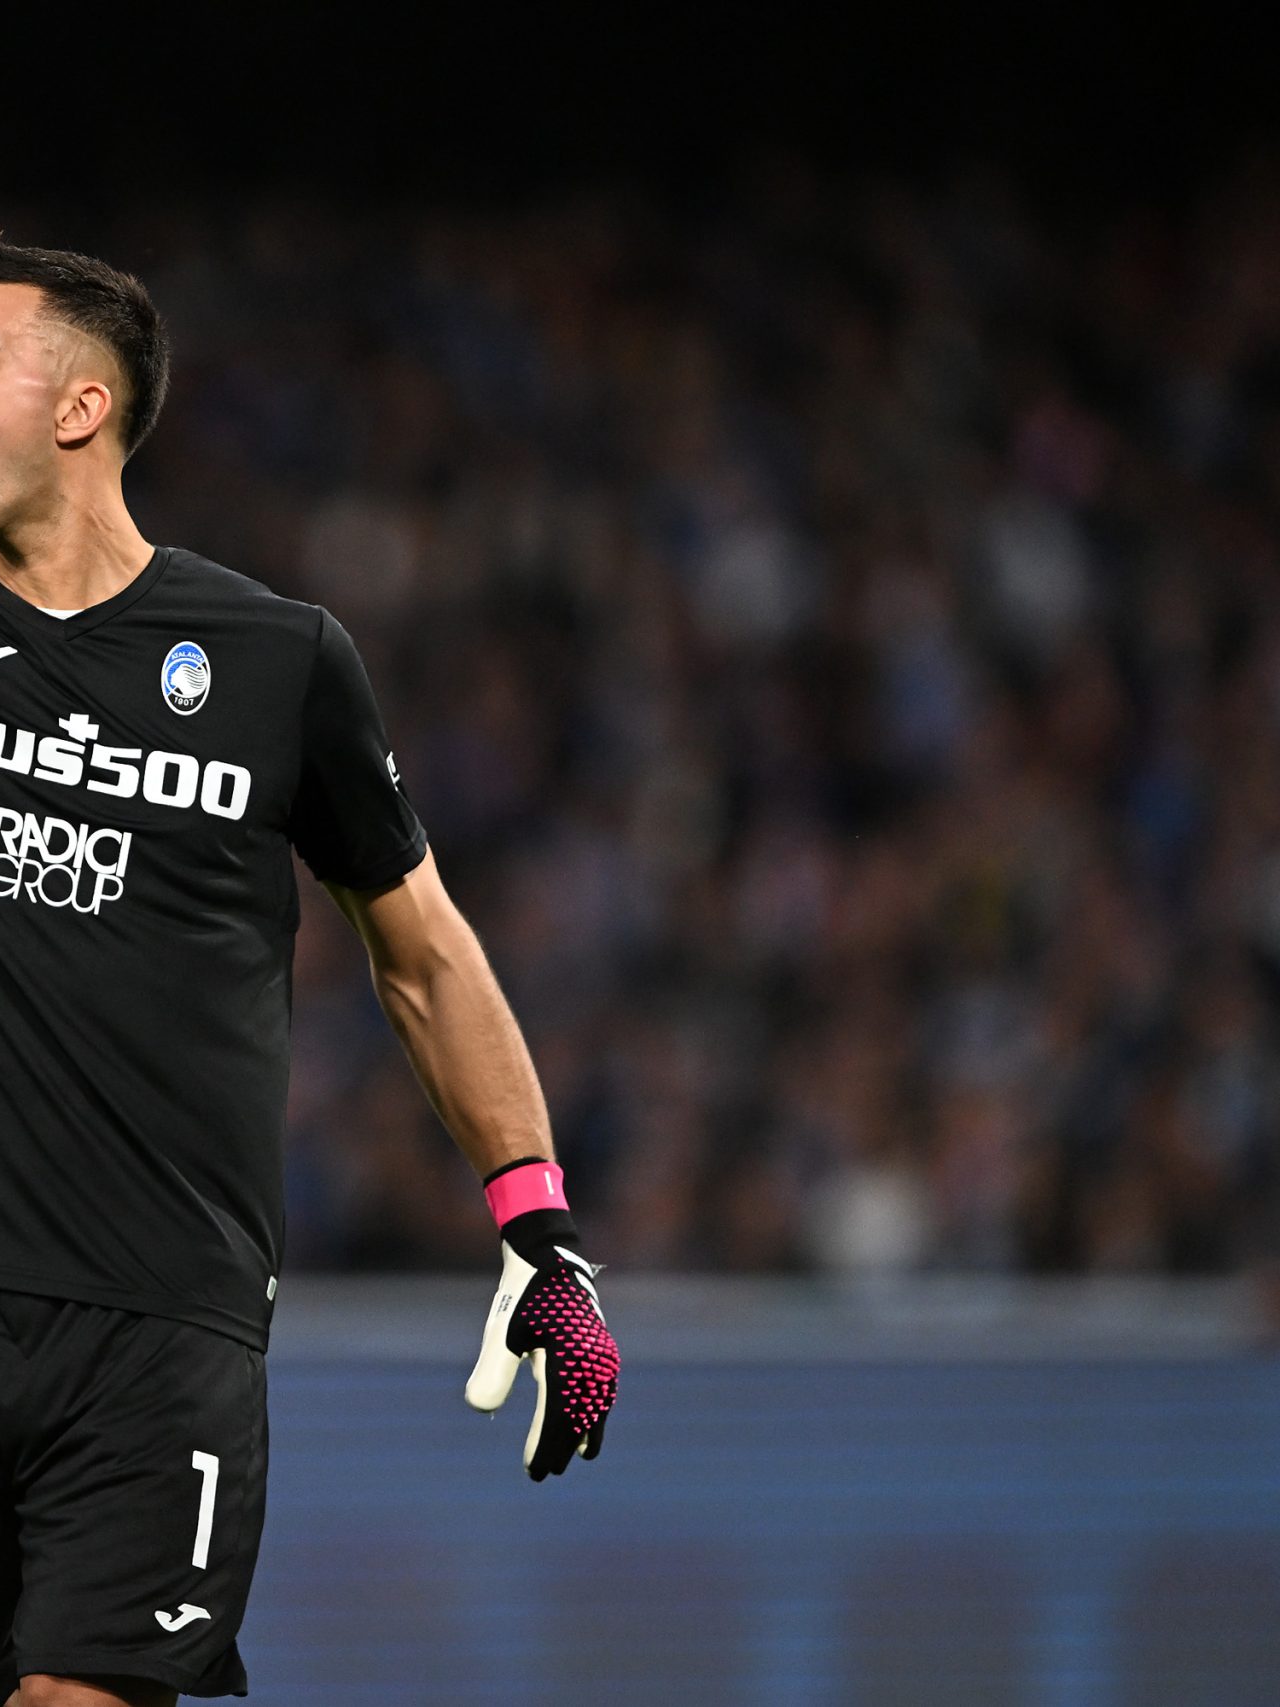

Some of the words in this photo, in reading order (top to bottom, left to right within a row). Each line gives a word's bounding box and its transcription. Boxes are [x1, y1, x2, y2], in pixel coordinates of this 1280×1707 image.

[171, 651, 204, 662] ATALANTA
[174, 696, 195, 706] 1907
[191, 1450, 219, 1571] 1
